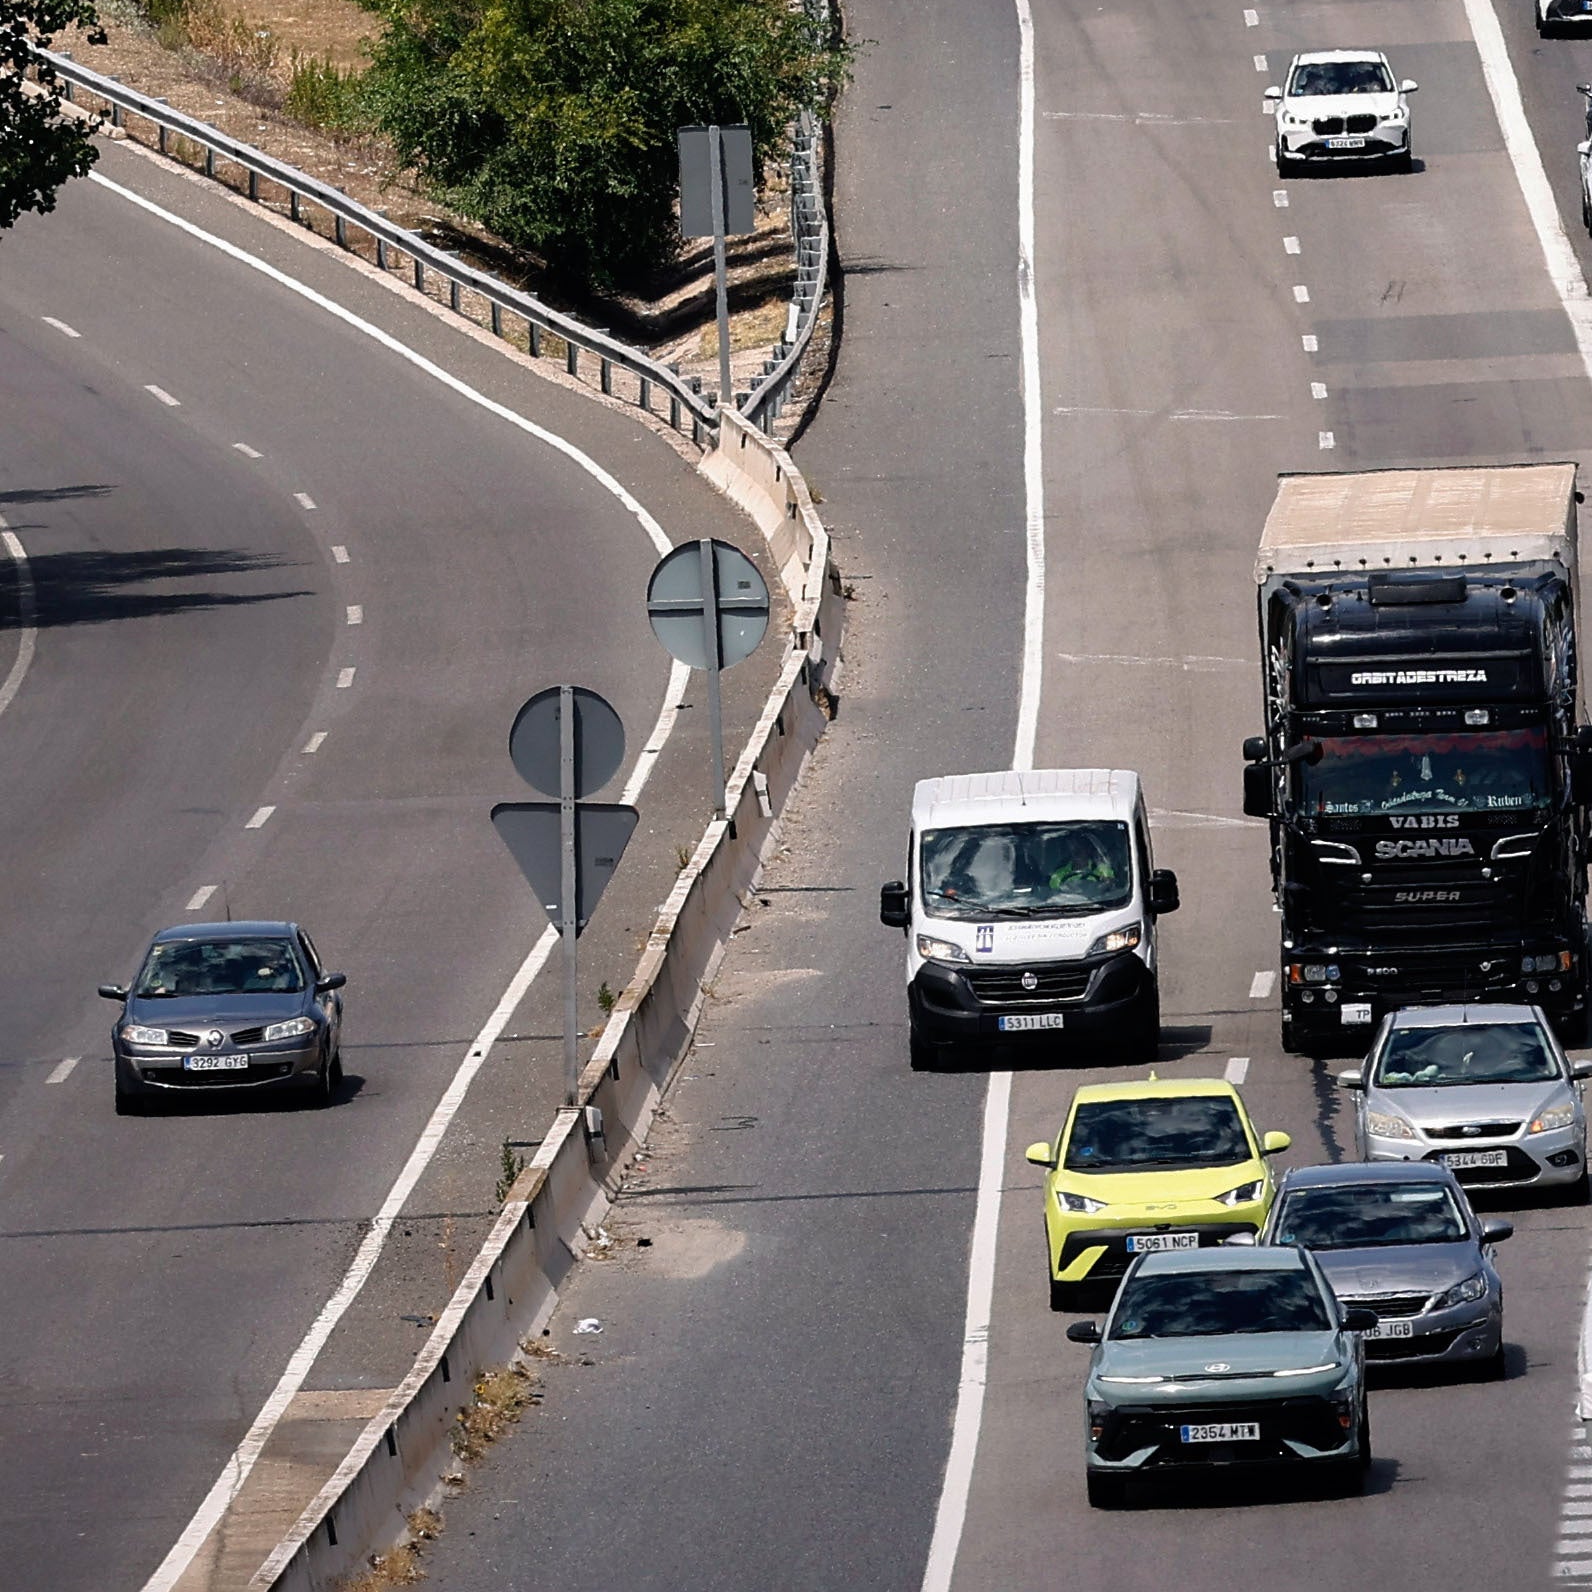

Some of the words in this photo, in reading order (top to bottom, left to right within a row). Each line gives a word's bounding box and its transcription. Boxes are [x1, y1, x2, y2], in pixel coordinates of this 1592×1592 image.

[1351, 670, 1487, 685] ORBITADESTREZA
[1325, 801, 1359, 813] Santos
[1389, 815, 1460, 829] VABIS
[1374, 838, 1475, 859] SCANIA
[1395, 891, 1461, 902] SUPER
[1356, 1010, 1370, 1019] TP
[1008, 1016, 1035, 1028] 5311
[1039, 1015, 1061, 1027] LLC
[193, 1057, 219, 1068] 3292
[1446, 1154, 1476, 1167] 5344
[1136, 1237, 1168, 1250] 5061
[1173, 1235, 1197, 1248] NCP
[1386, 1323, 1411, 1336] JGB
[1191, 1426, 1226, 1440] 2354
